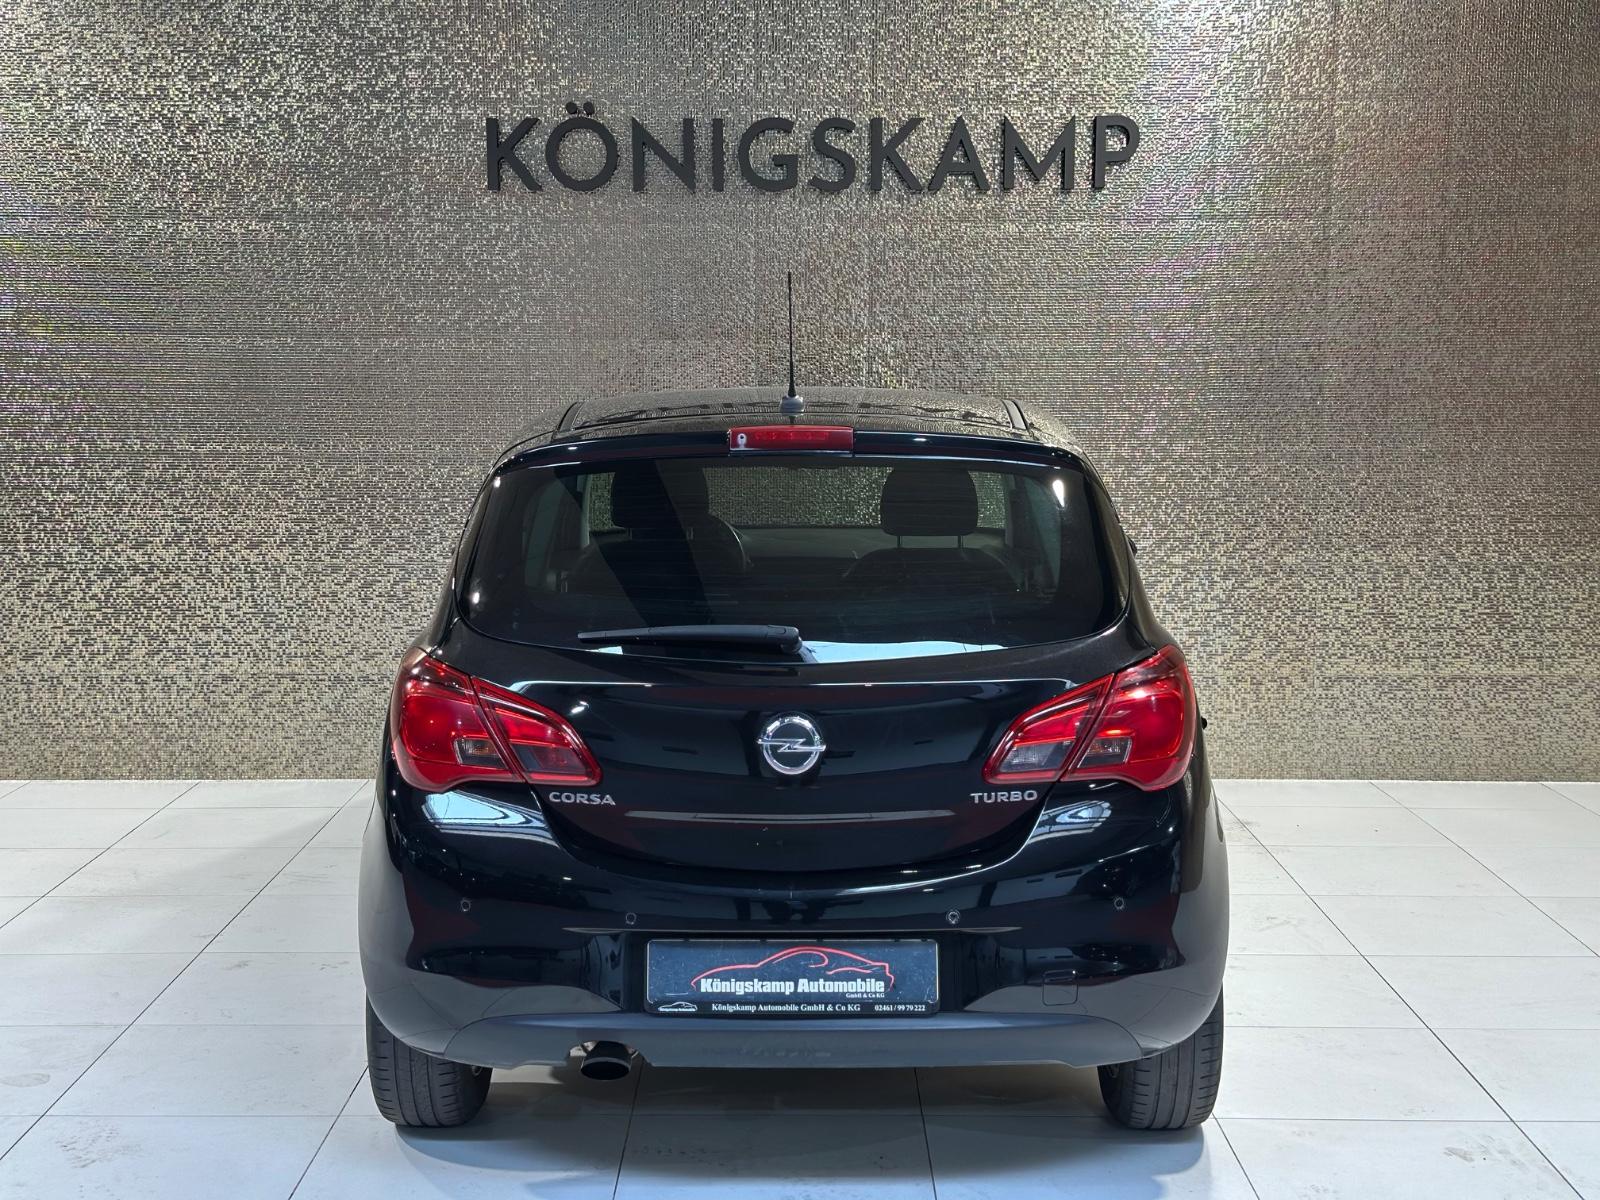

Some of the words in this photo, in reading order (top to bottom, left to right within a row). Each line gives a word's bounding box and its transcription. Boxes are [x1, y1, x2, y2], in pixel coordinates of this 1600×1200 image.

[486, 101, 1141, 192] KÖNIGSKAMP
[549, 791, 616, 806] CORSA
[970, 789, 1038, 804] TURBO
[700, 978, 794, 995] Königskamp
[797, 978, 885, 993] Automobile
[711, 1003, 757, 1012] Königskamp
[758, 1003, 799, 1012] Automobile
[800, 1003, 825, 1012] GmbH
[826, 1004, 834, 1012] &
[835, 1004, 846, 1012] Co
[847, 1004, 861, 1012] KG
[874, 1004, 893, 1012] 02461
